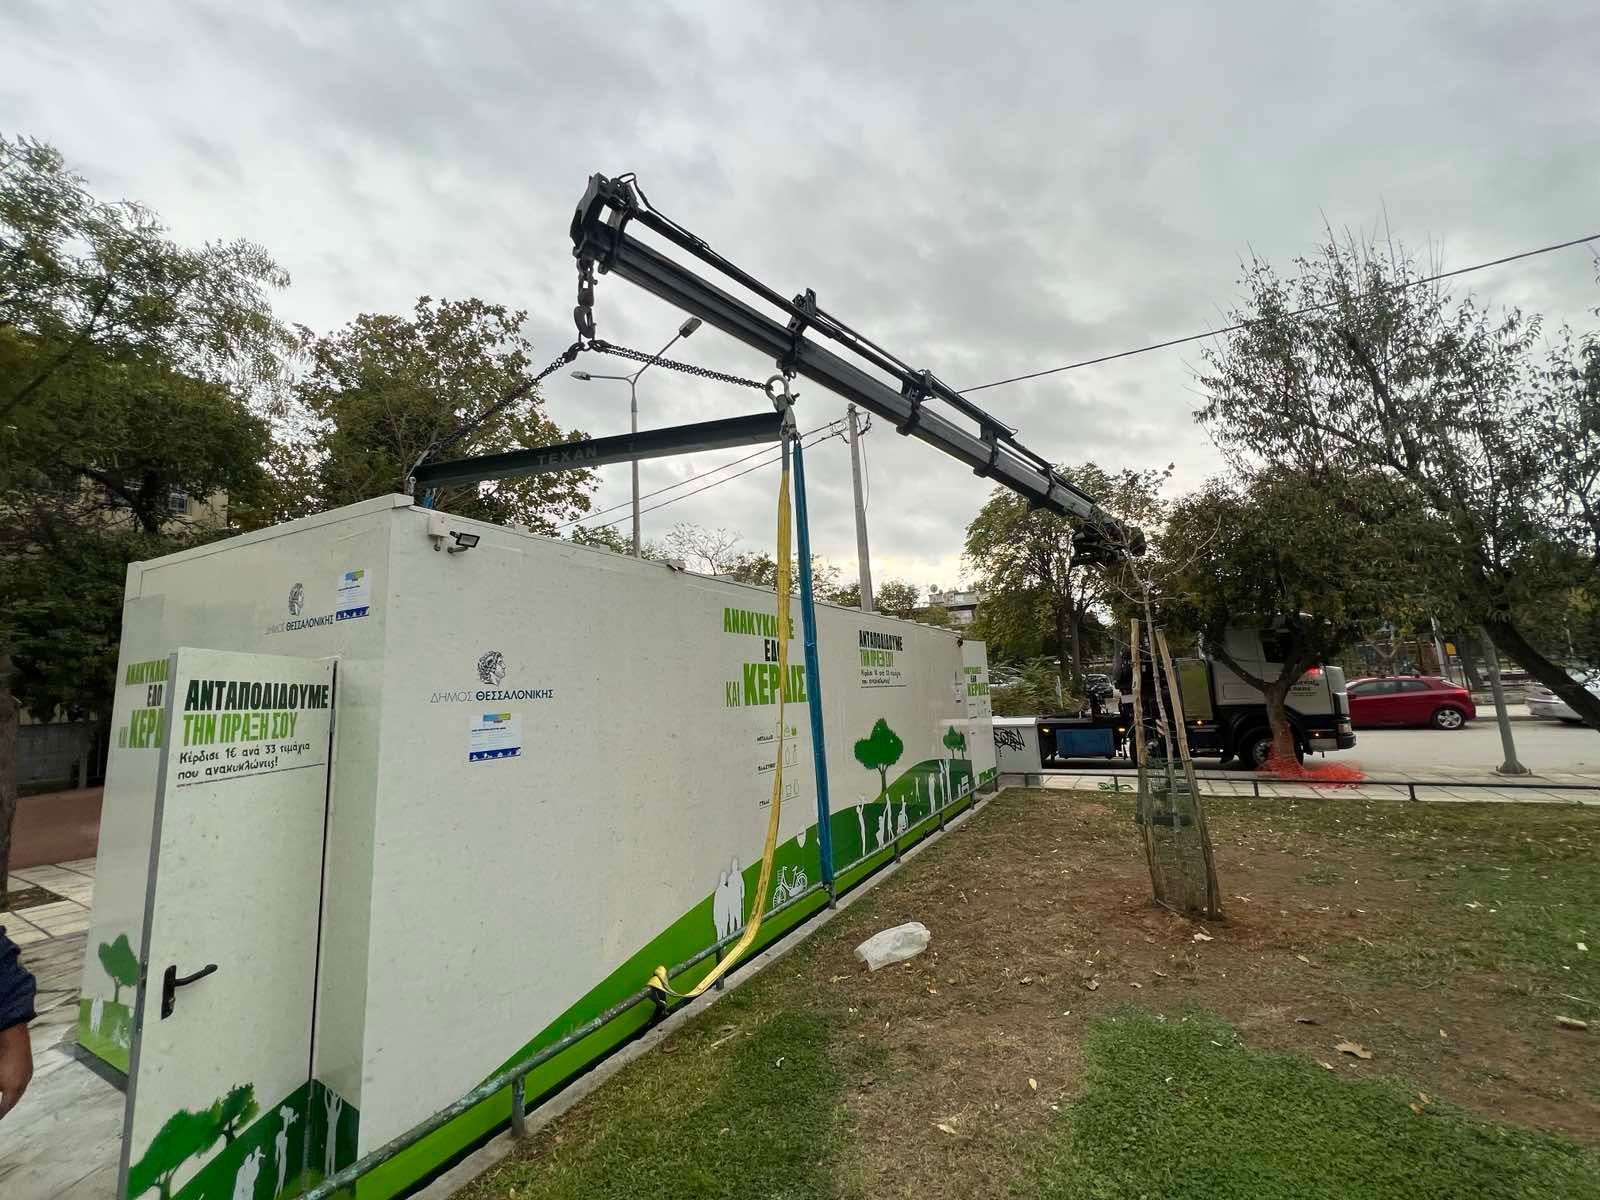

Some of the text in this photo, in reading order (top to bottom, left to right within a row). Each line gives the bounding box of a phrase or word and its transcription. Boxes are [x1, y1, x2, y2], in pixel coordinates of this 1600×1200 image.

[184, 679, 330, 711] ΑΝΤΑΠΟΔΙΔΟΥΜΕ
[430, 689, 554, 703] ΔΗΜΟΣ ΘΕΣΣΑΛΟΝΙΚΗΣ
[183, 711, 299, 747] ΤΗΝ ΠΡΑΞΗ ΣΟΥ
[179, 750, 220, 766] Κέρδισε
[242, 744, 260, 757] ανά
[265, 744, 276, 754] 33
[177, 771, 199, 781] που
